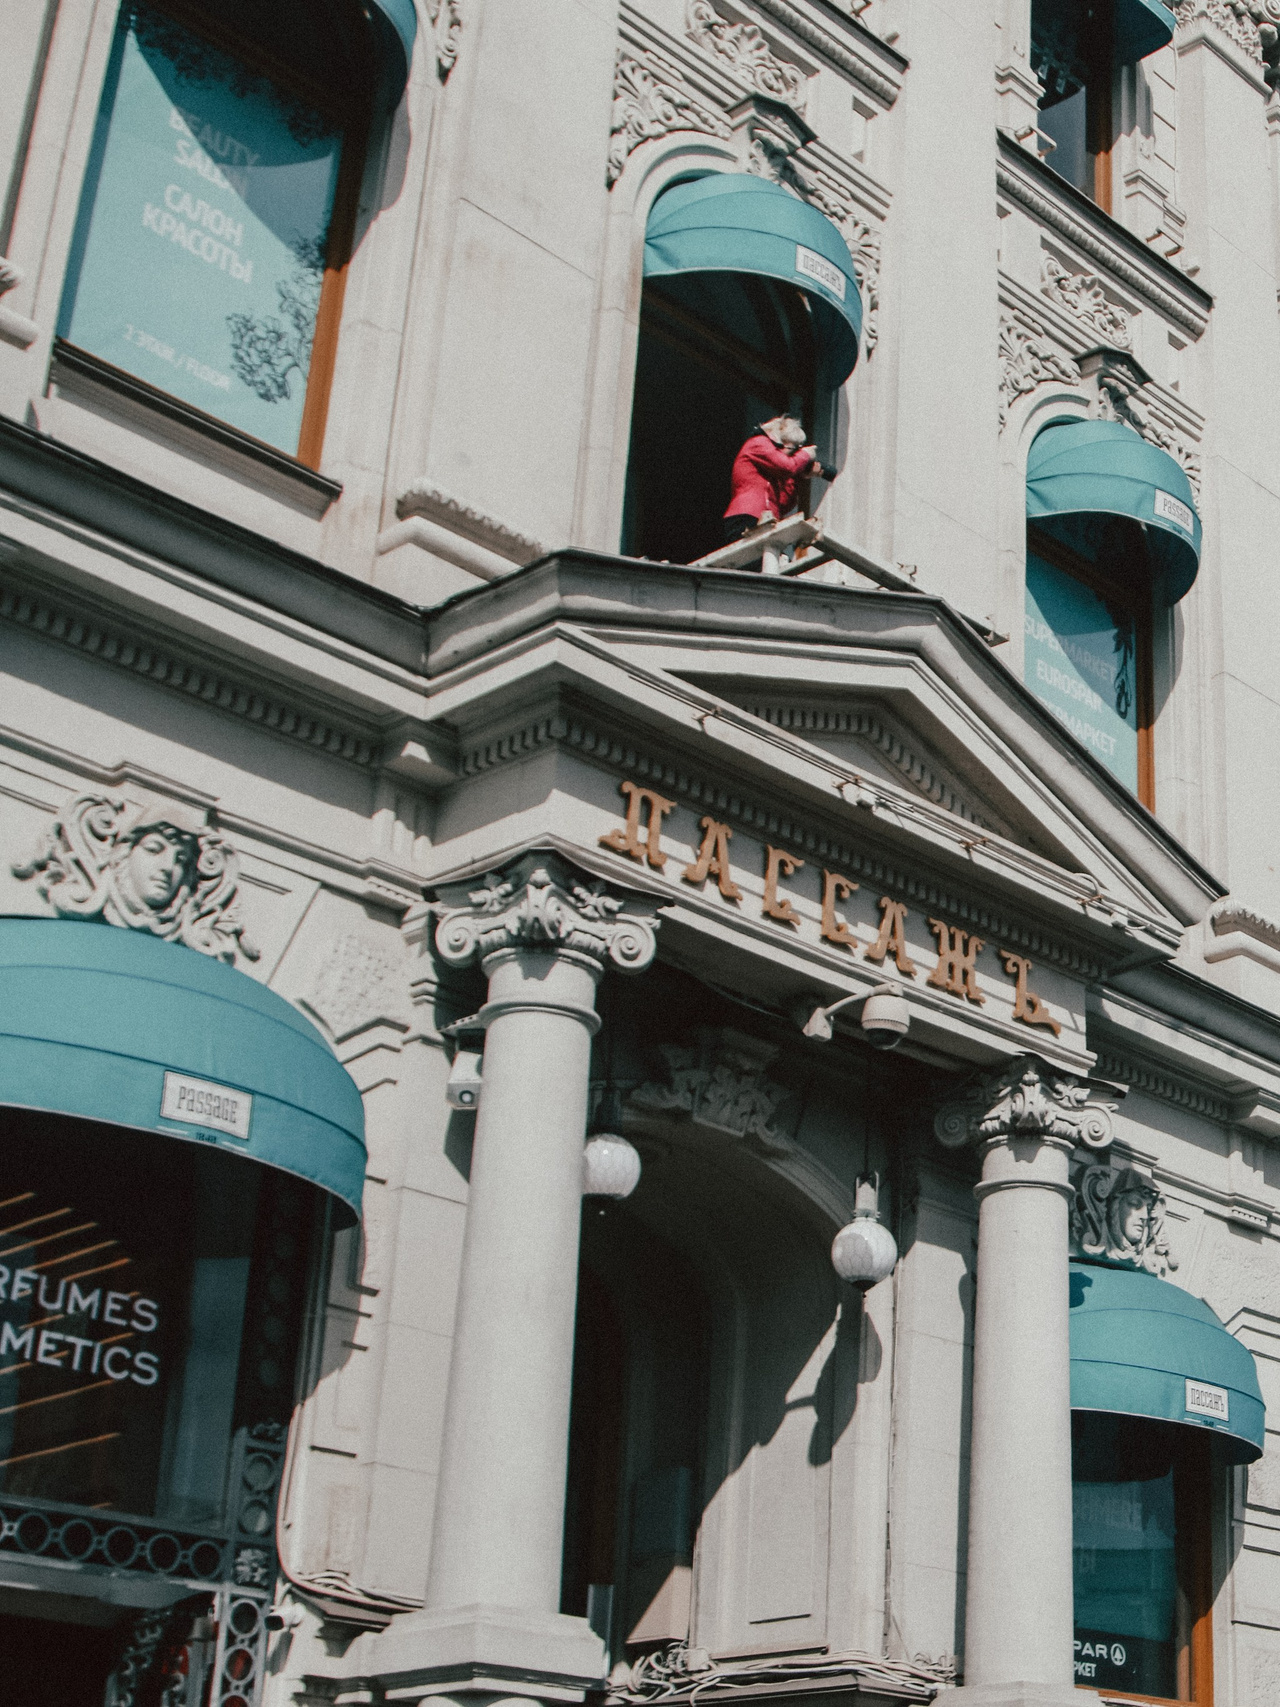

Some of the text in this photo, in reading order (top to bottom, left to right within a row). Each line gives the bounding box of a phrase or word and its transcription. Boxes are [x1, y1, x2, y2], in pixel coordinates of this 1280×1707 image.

[168, 106, 260, 165] BEAUTY
[142, 202, 253, 284] КРАСОТЫ
[164, 184, 243, 246] САЛОН
[1037, 659, 1103, 713] EUROSPAR
[598, 780, 1063, 1038] ПАССАЖЪ
